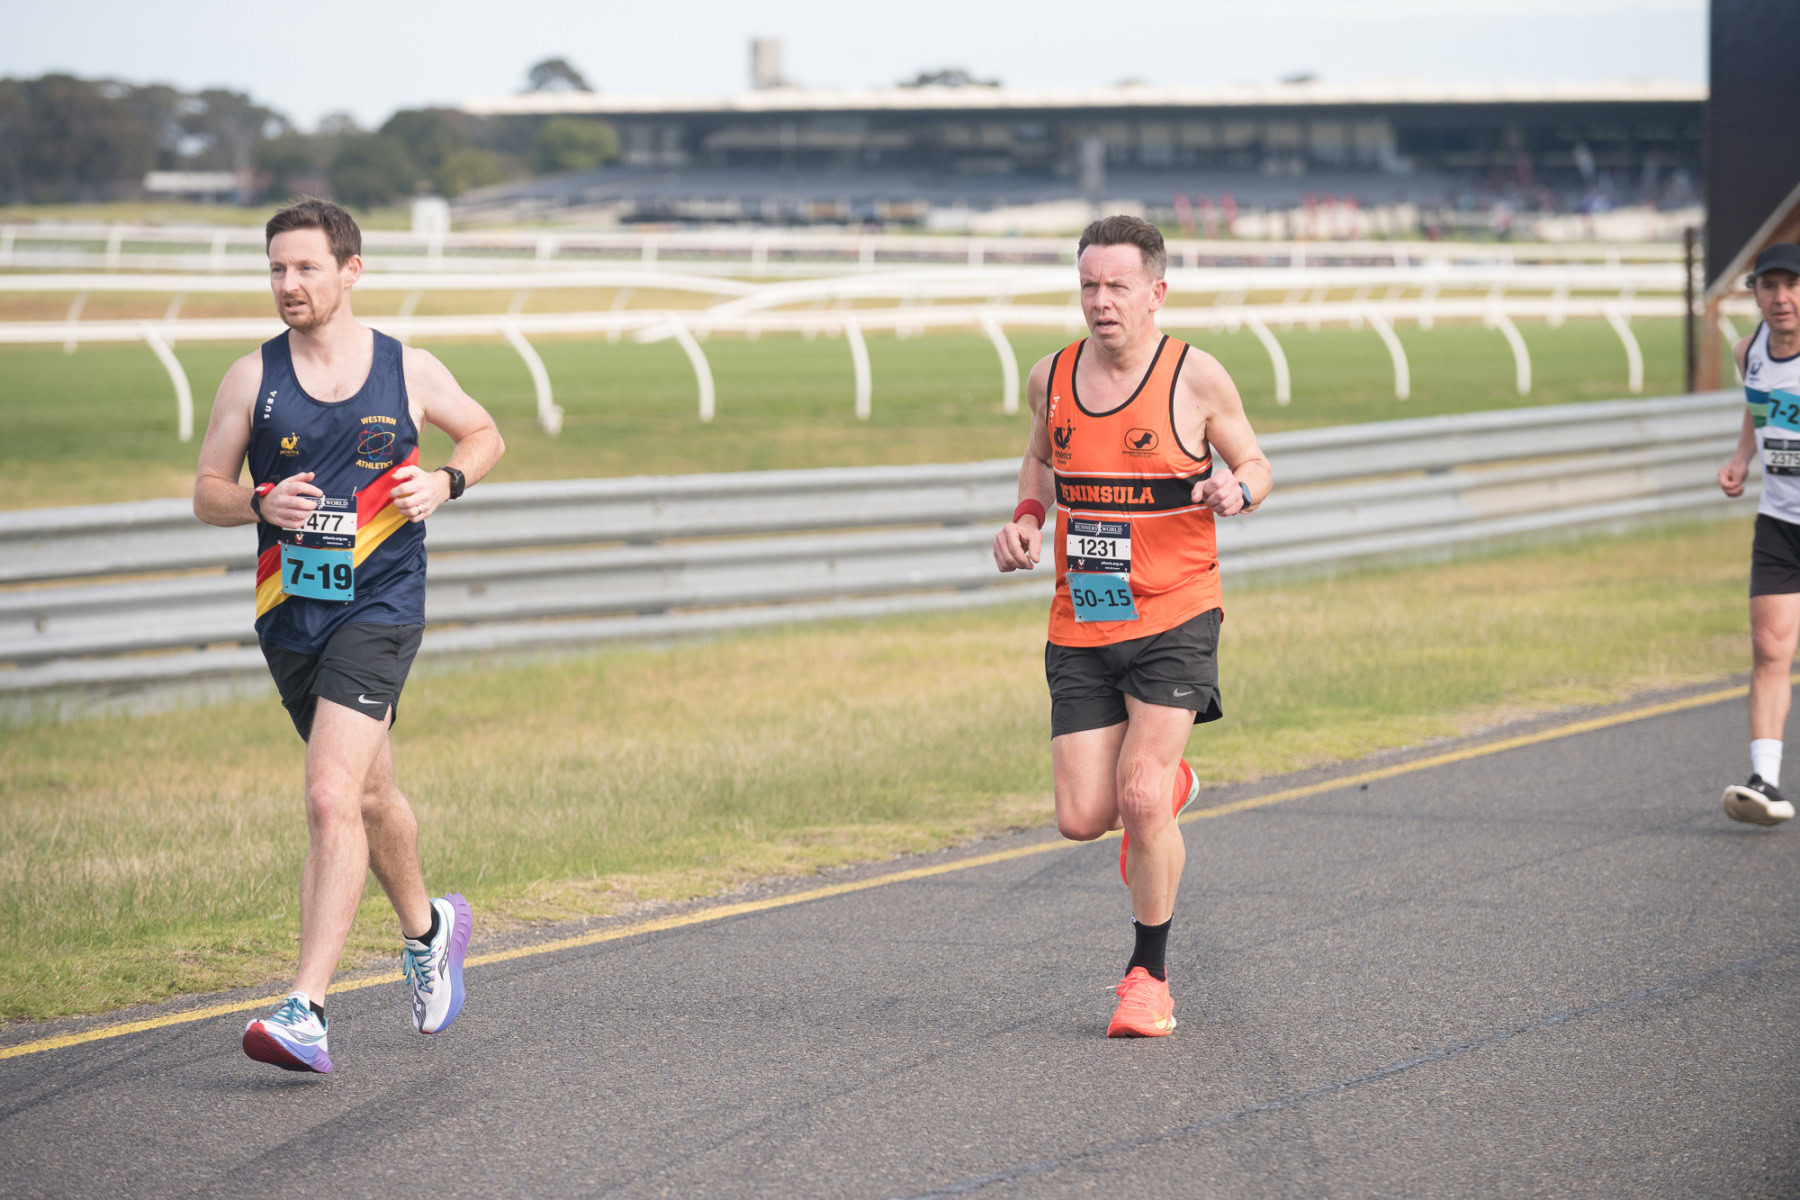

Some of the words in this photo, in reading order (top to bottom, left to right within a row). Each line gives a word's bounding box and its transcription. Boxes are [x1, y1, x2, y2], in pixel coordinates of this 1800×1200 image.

[360, 415, 397, 426] WESTERN
[355, 459, 394, 470] ATHLETICS
[301, 513, 344, 531] 477
[1078, 538, 1116, 557] 1231
[287, 558, 352, 590] 7-19
[1073, 588, 1131, 608] 50-15
